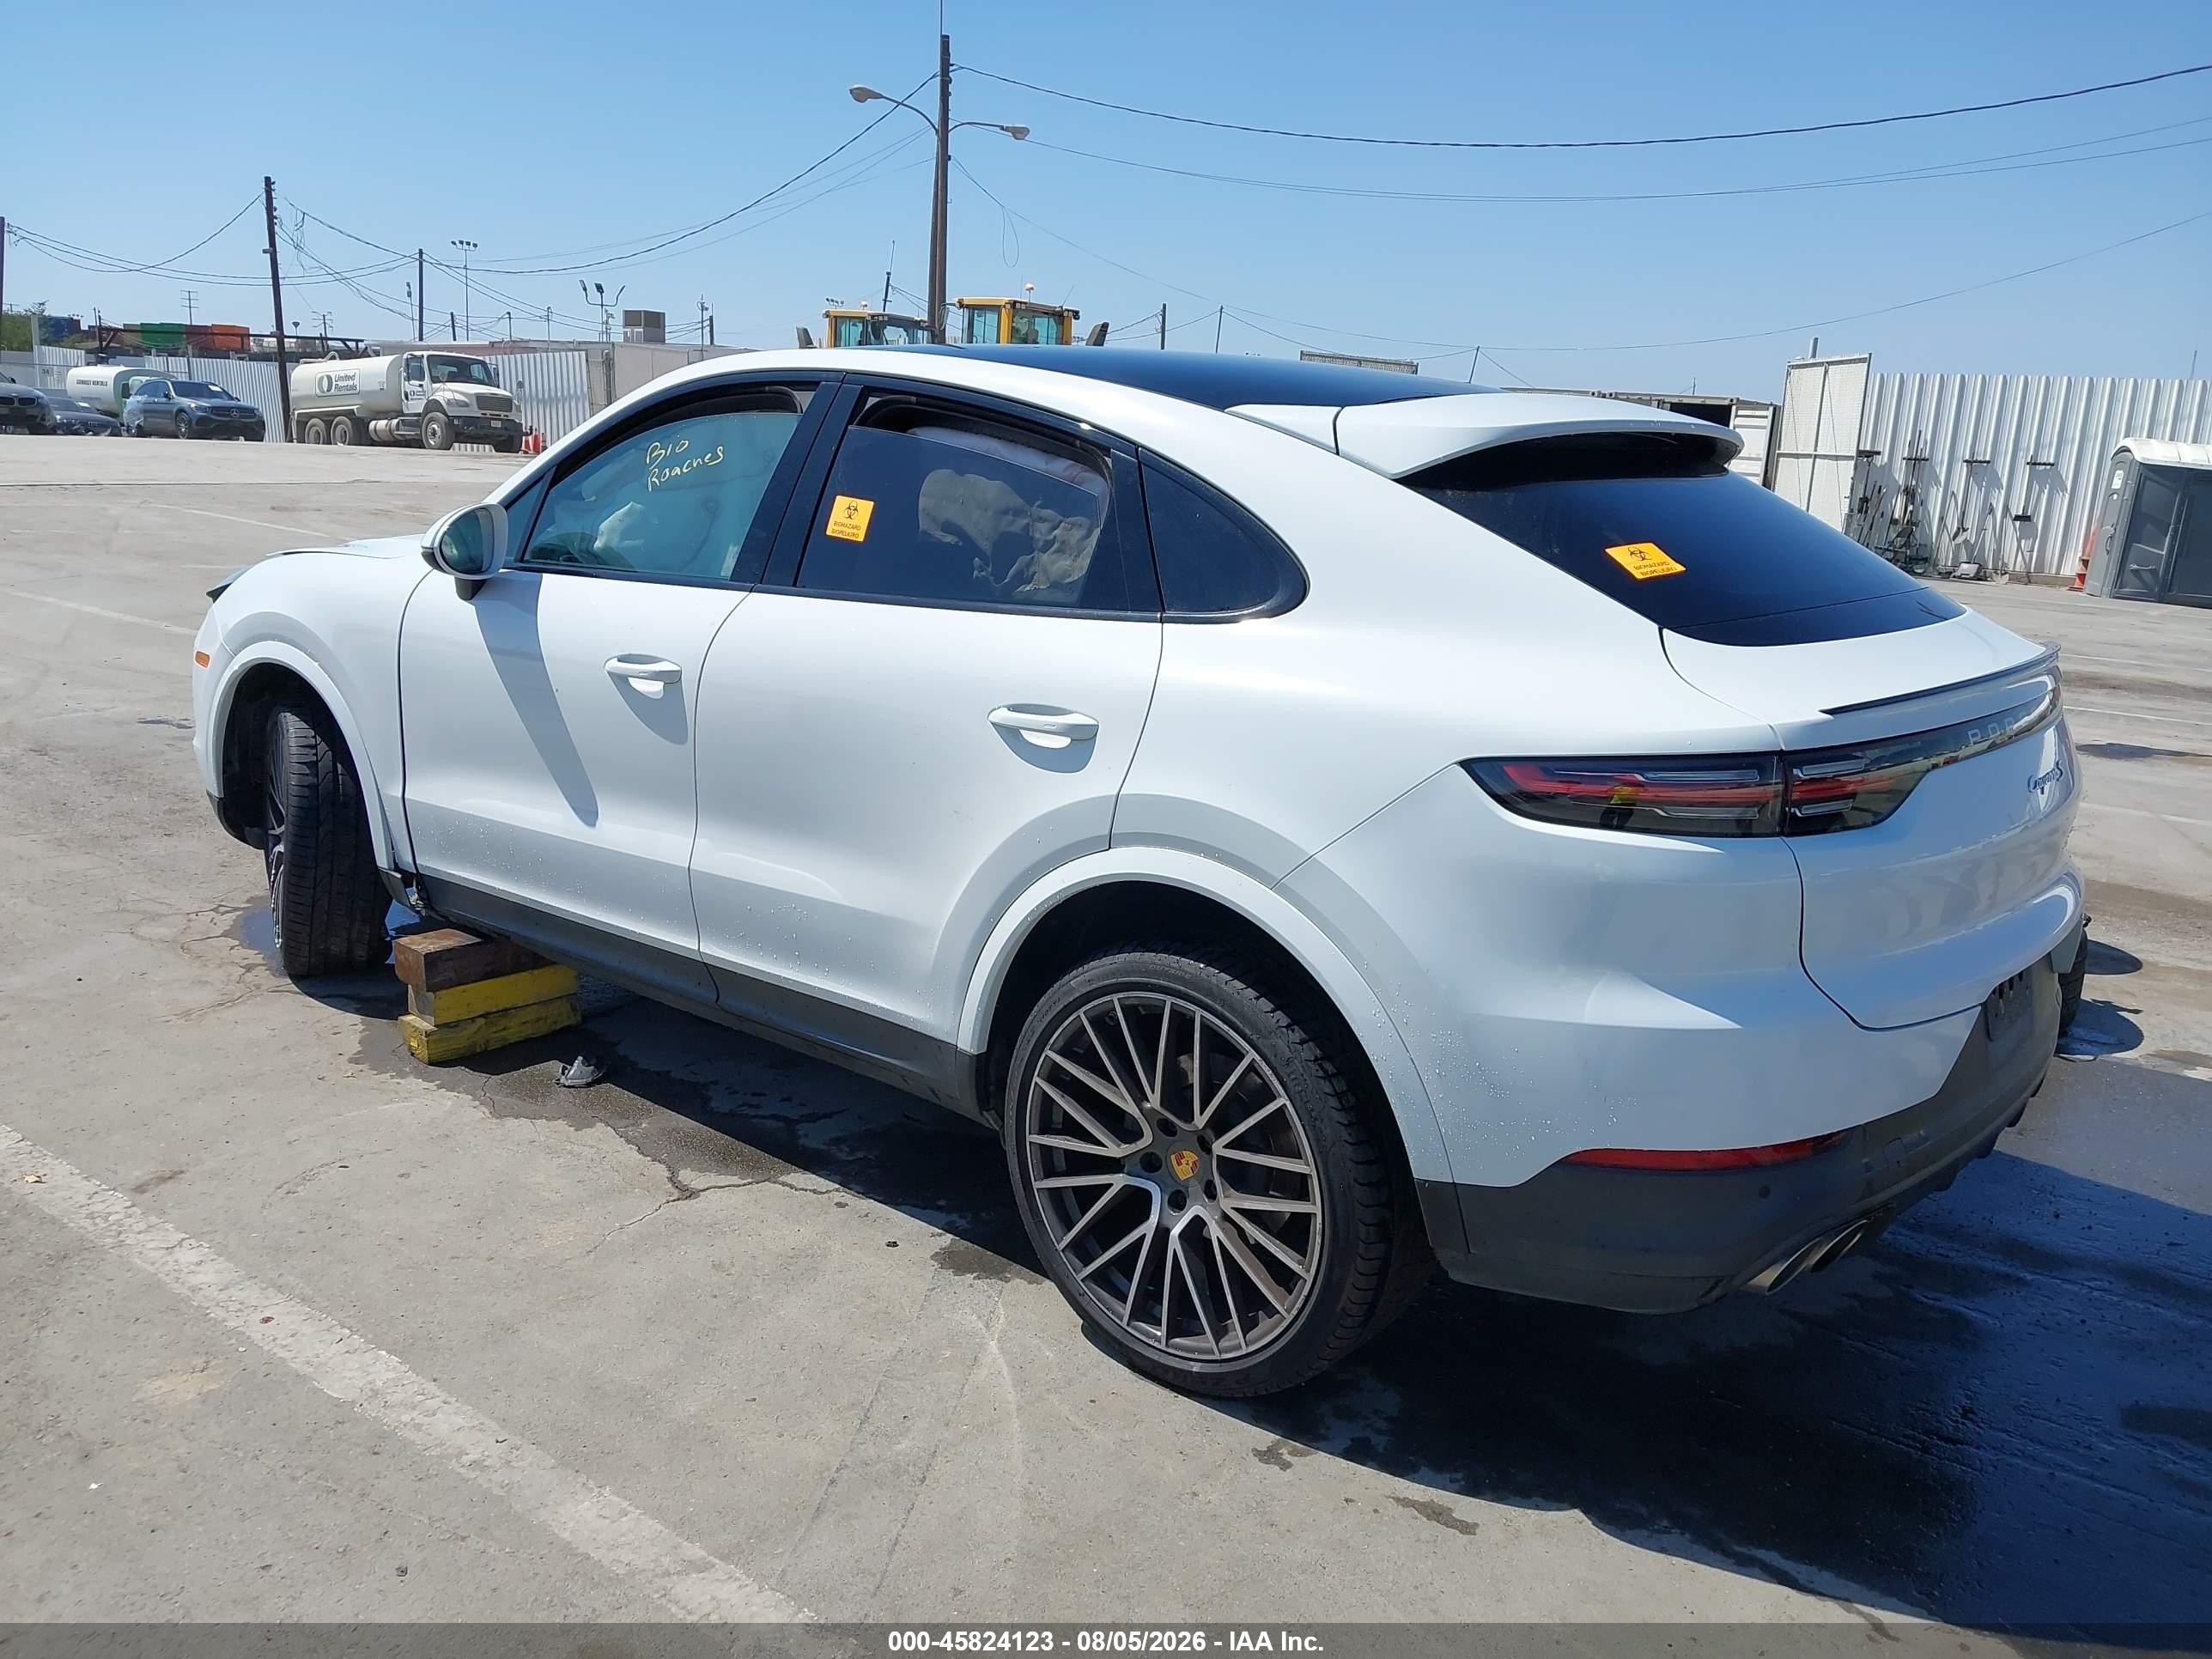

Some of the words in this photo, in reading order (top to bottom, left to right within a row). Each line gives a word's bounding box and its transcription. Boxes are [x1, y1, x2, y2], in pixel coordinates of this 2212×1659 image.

[334, 372, 356, 383] United
[334, 382, 358, 392] Rentals
[833, 520, 861, 531] BIOHAZARD
